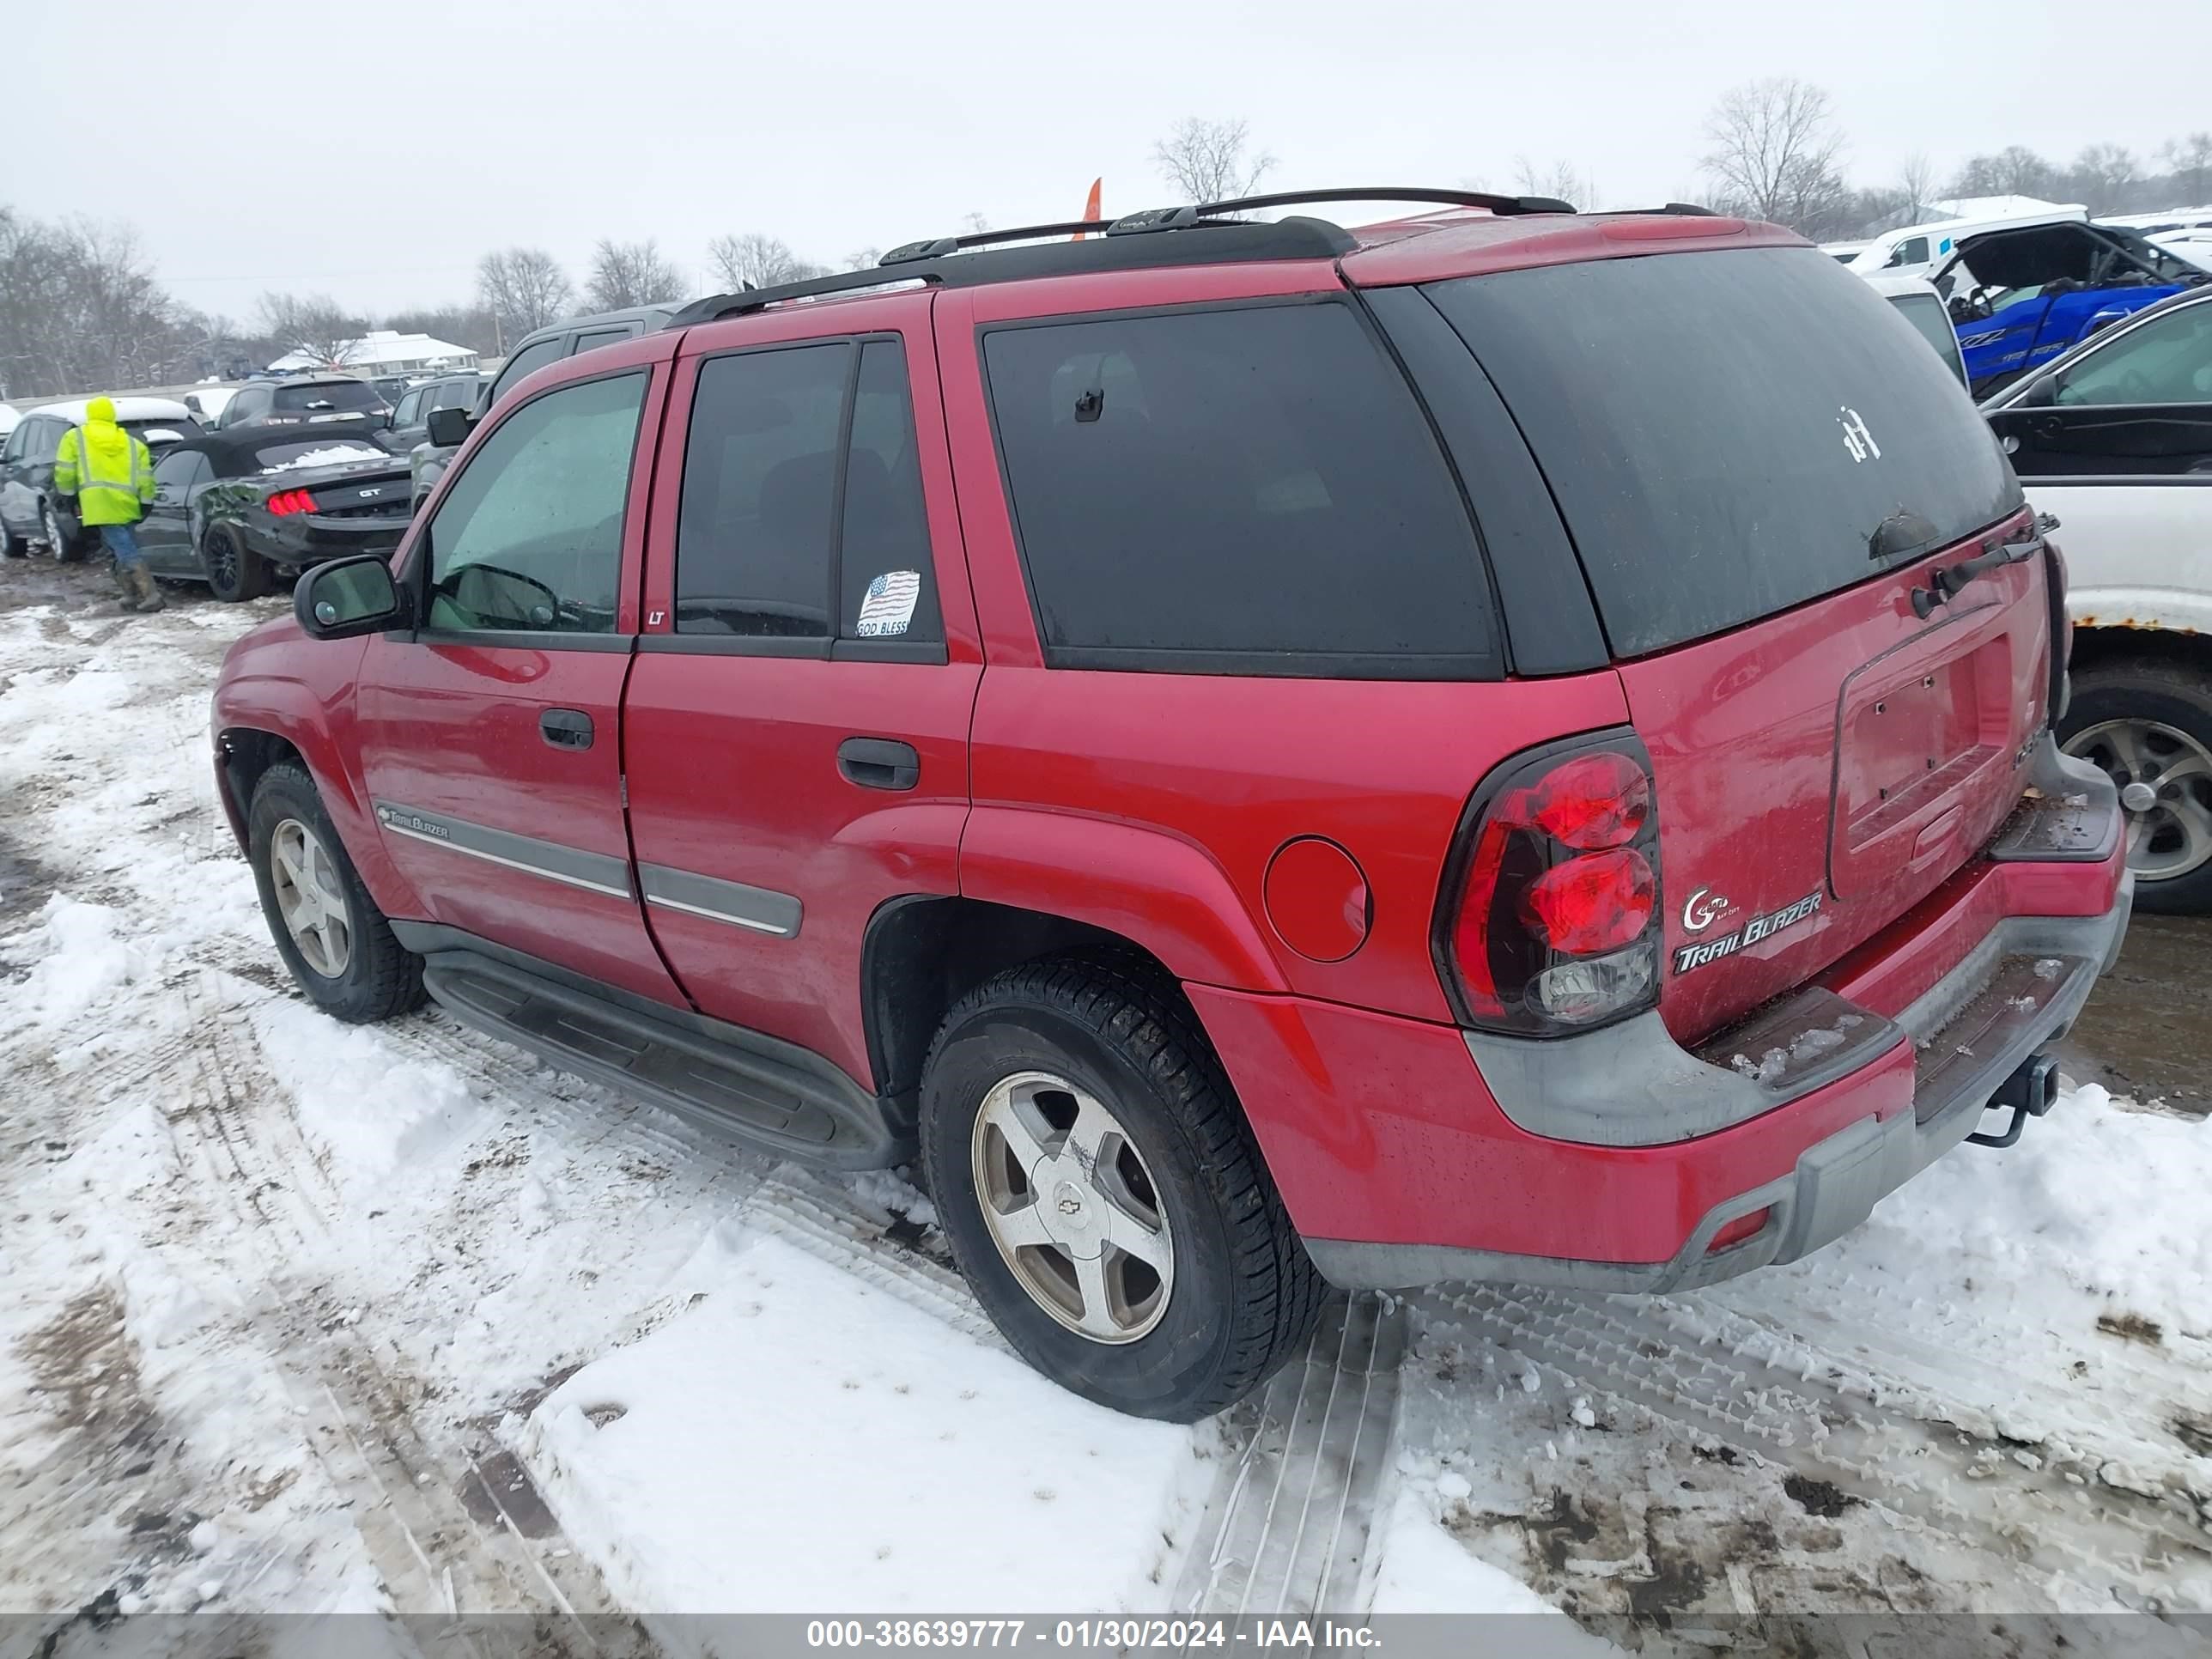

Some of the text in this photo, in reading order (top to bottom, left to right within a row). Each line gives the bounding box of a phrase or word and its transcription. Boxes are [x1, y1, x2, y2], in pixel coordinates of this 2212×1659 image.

[358, 487, 382, 498] GT
[647, 611, 665, 625] LT
[858, 620, 908, 635] GOD BLESS
